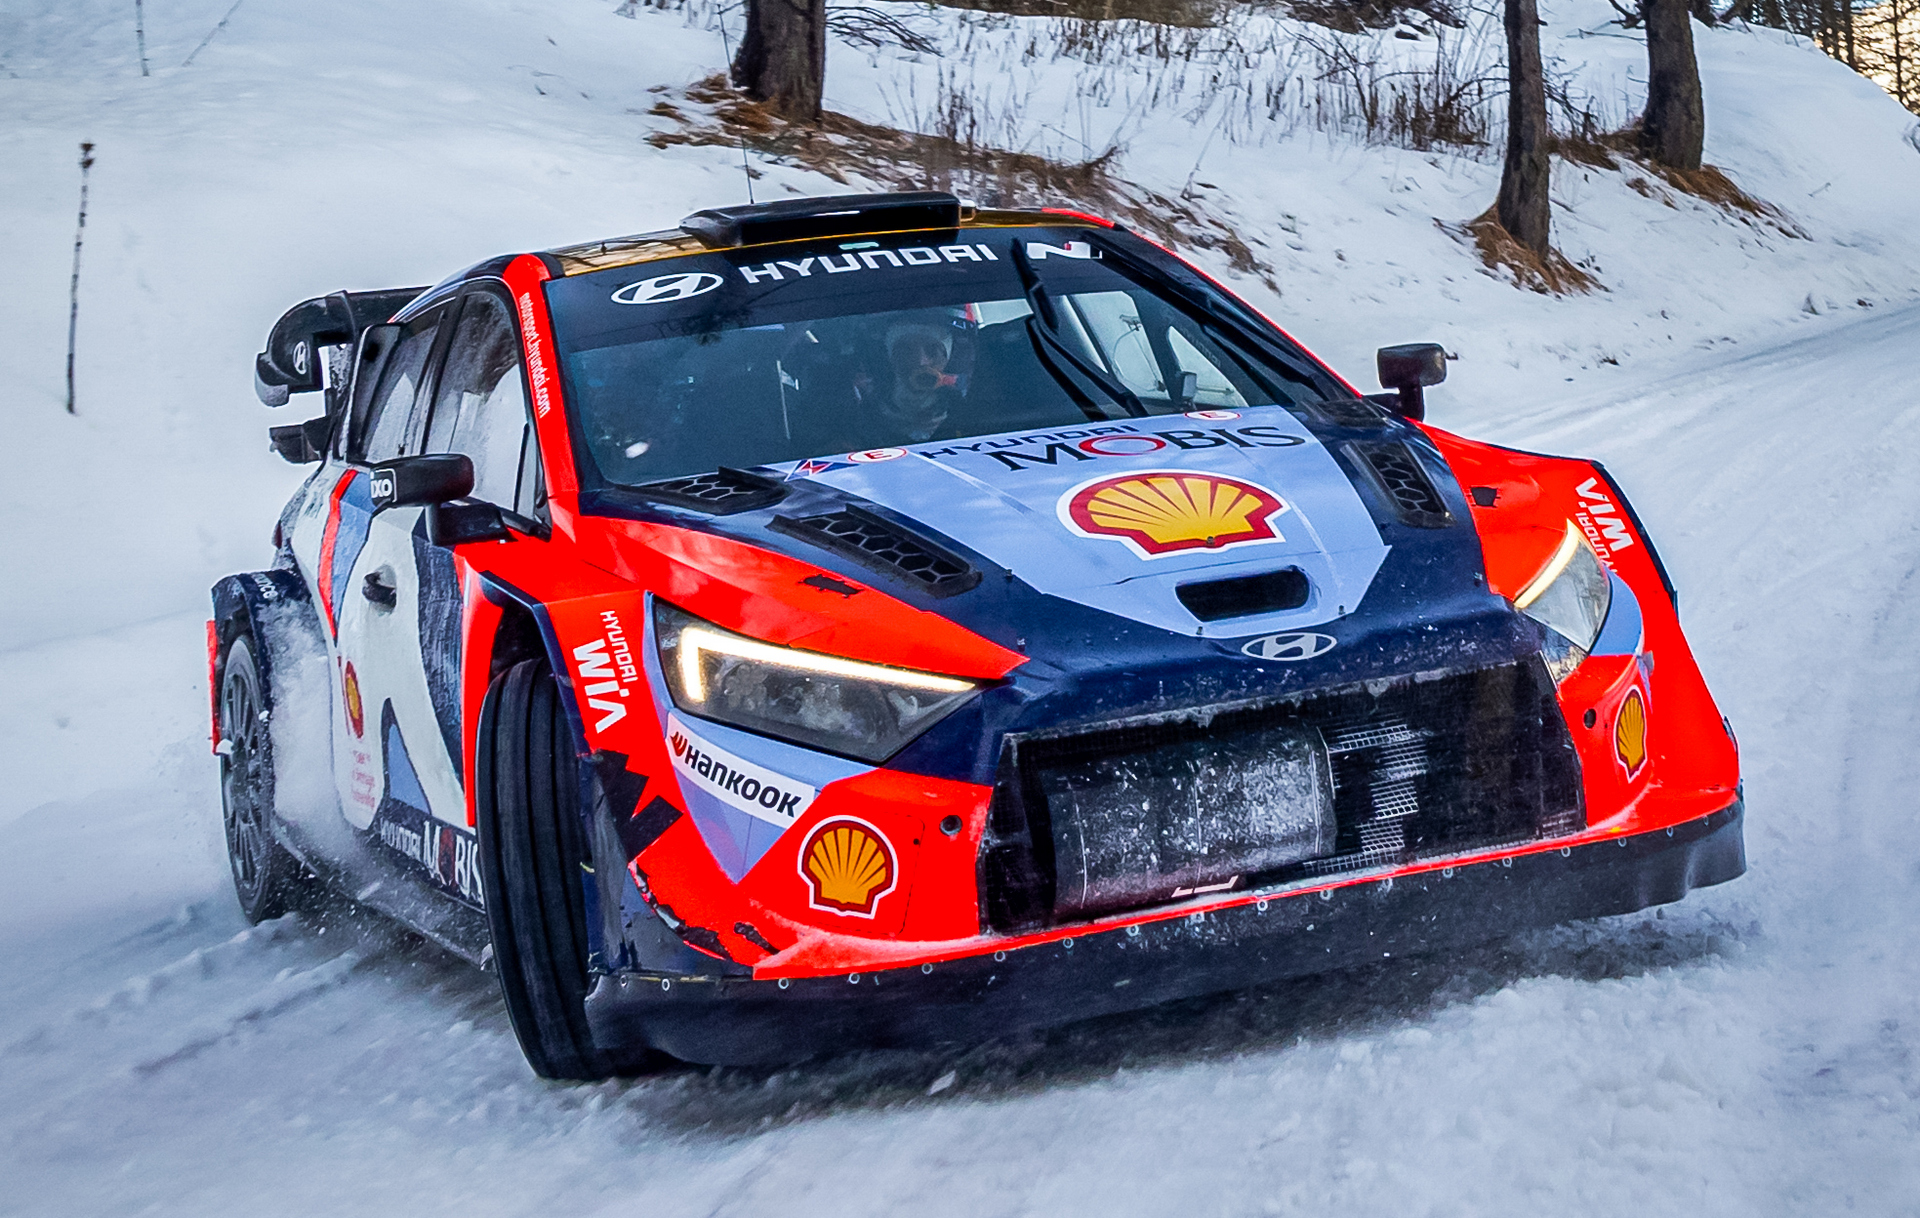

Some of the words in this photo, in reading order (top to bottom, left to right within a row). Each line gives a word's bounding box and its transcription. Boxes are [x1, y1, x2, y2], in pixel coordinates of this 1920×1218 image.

[739, 244, 998, 283] HYUNDAI
[1026, 241, 1092, 259] N
[519, 292, 551, 418] motorsport.hyundai.com
[919, 425, 1140, 459] HYUNDAI
[983, 427, 1306, 471] MOBIS
[1575, 512, 1618, 573] YUNDAI
[600, 610, 638, 683] HYUNDAI
[684, 744, 802, 818] HanKOOK
